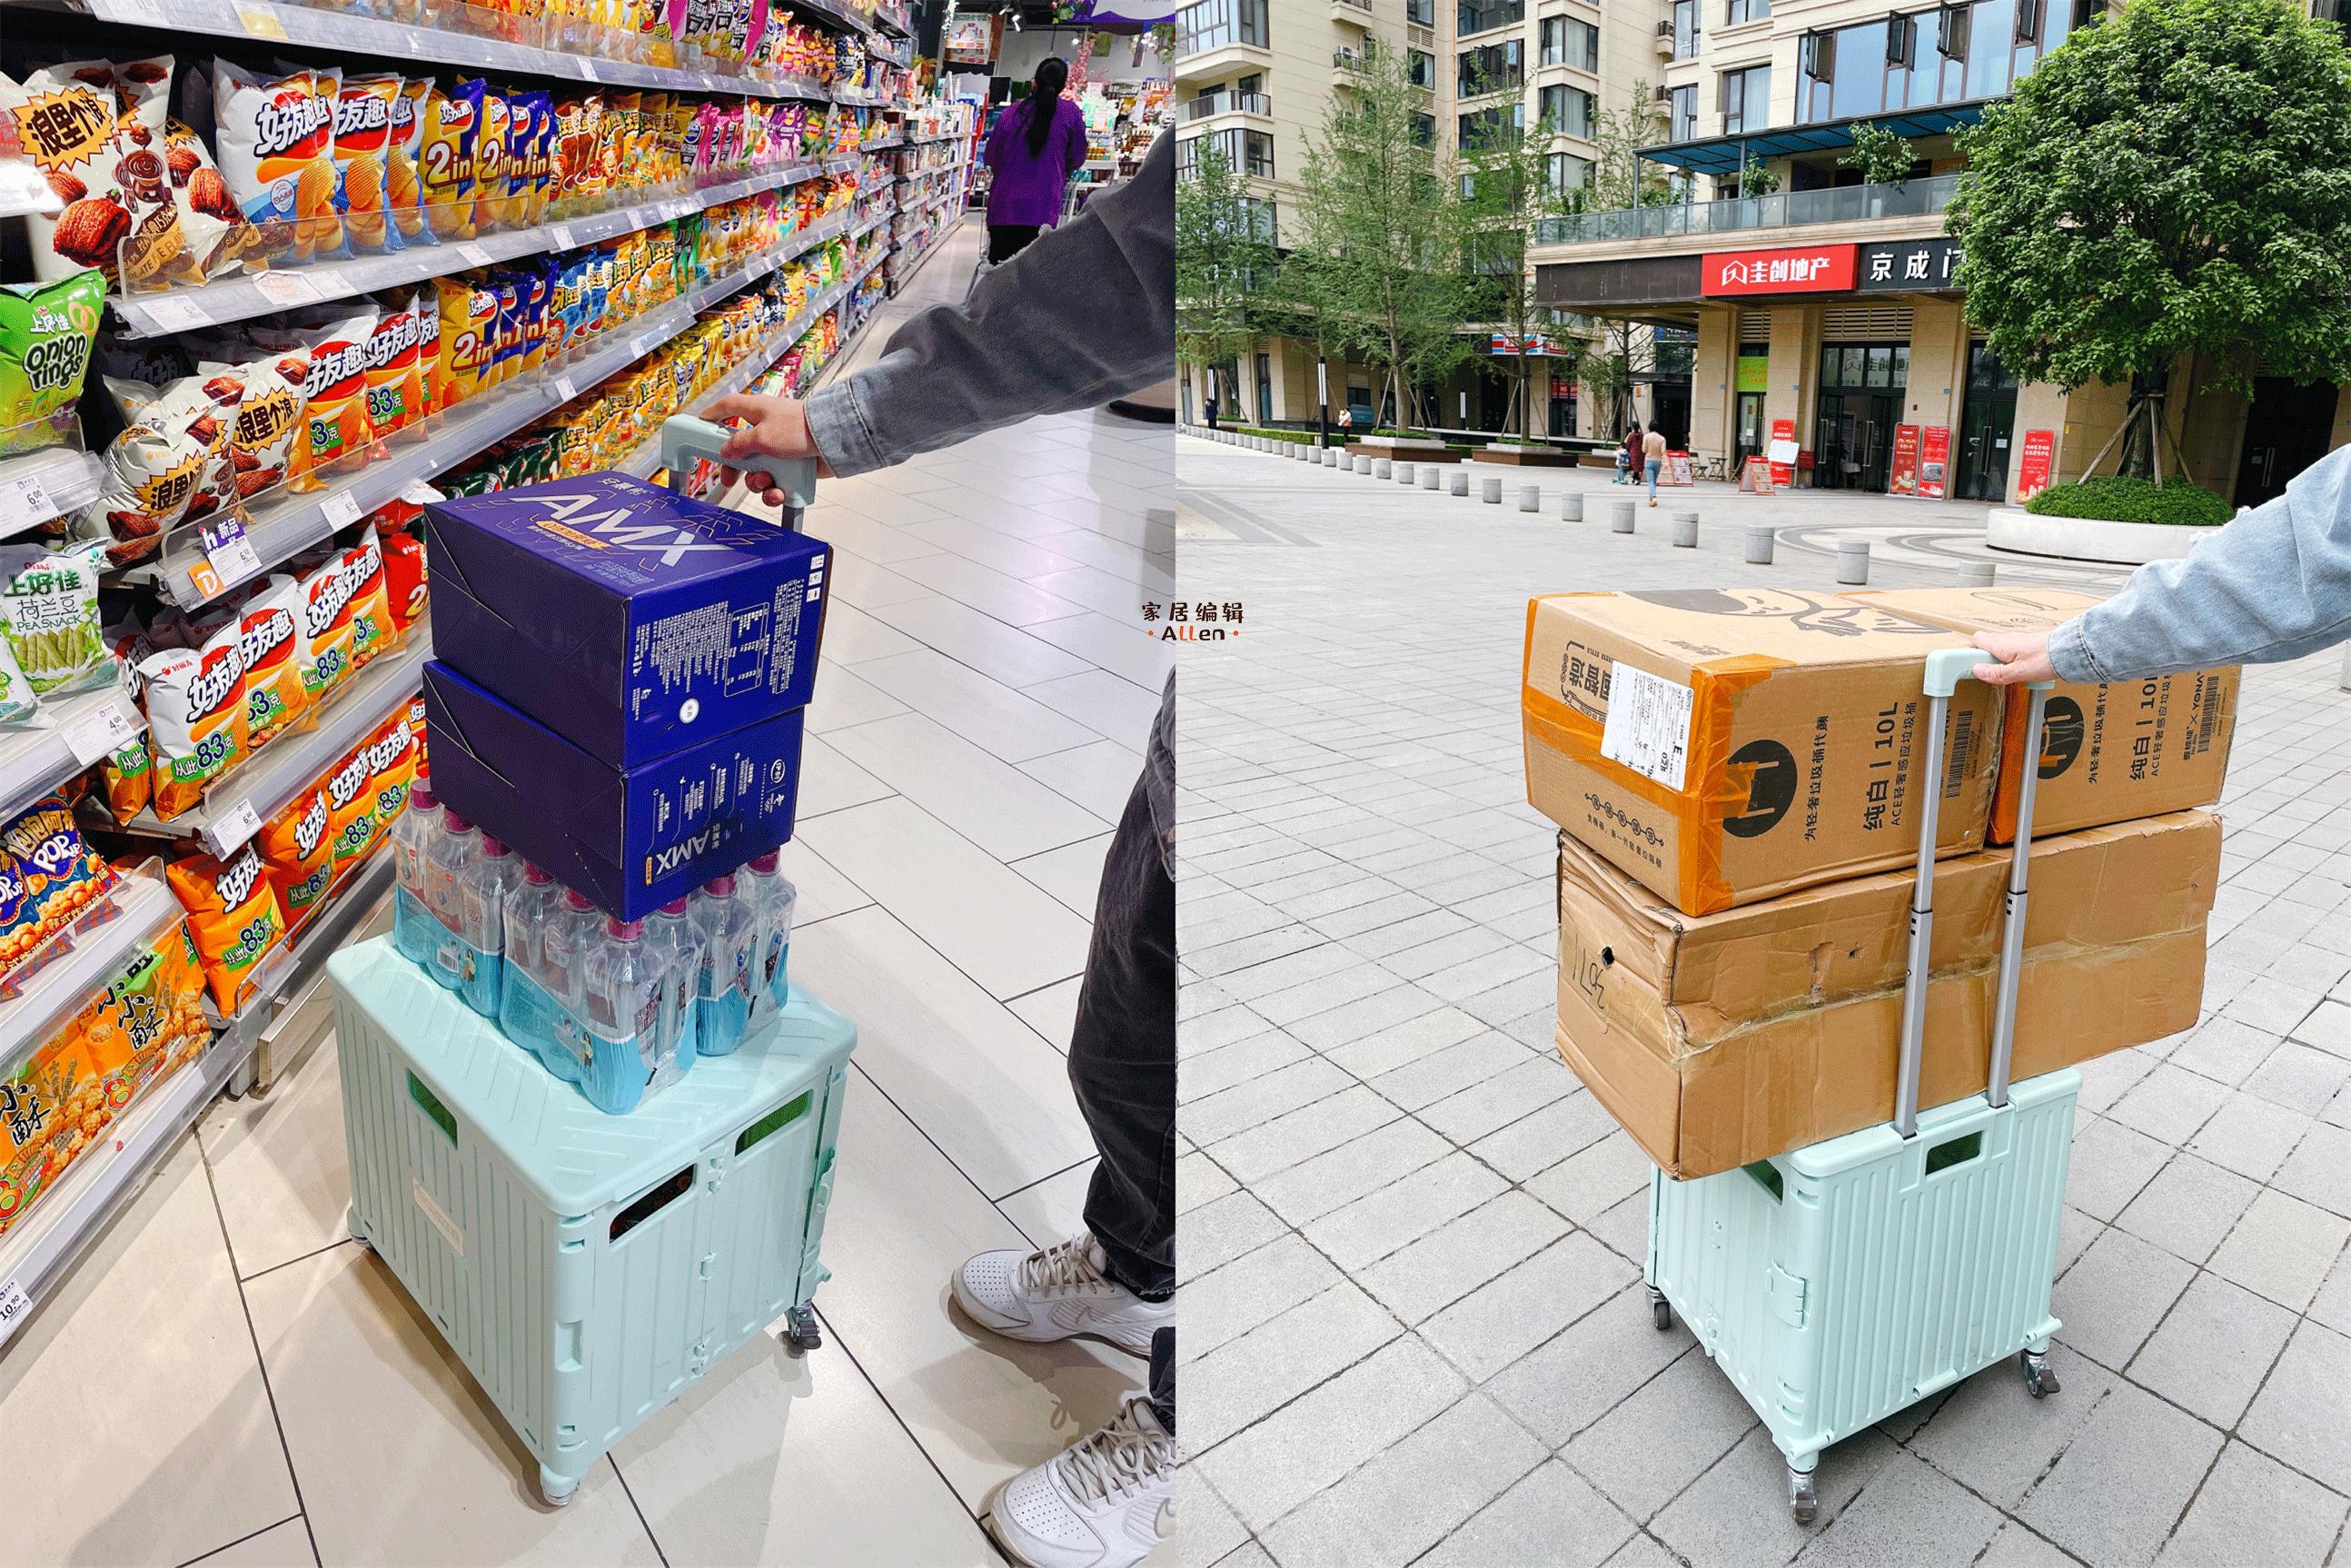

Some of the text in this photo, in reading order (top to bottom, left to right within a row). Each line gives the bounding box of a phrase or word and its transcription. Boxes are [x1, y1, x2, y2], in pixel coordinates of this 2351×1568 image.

[26, 97, 104, 158] 浪里个浪
[1749, 257, 1831, 283] 圭创地产
[28, 353, 84, 392] rings
[236, 398, 294, 443] 浪里个浪
[510, 493, 736, 568] AMX
[4, 568, 83, 598] 上好佳
[16, 614, 83, 632] PEA SNACK
[1875, 702, 1899, 749] 10L
[2130, 736, 2152, 781] 纯白
[1863, 779, 1890, 830] 纯白
[33, 834, 70, 874] POP
[654, 828, 712, 877] AMX
